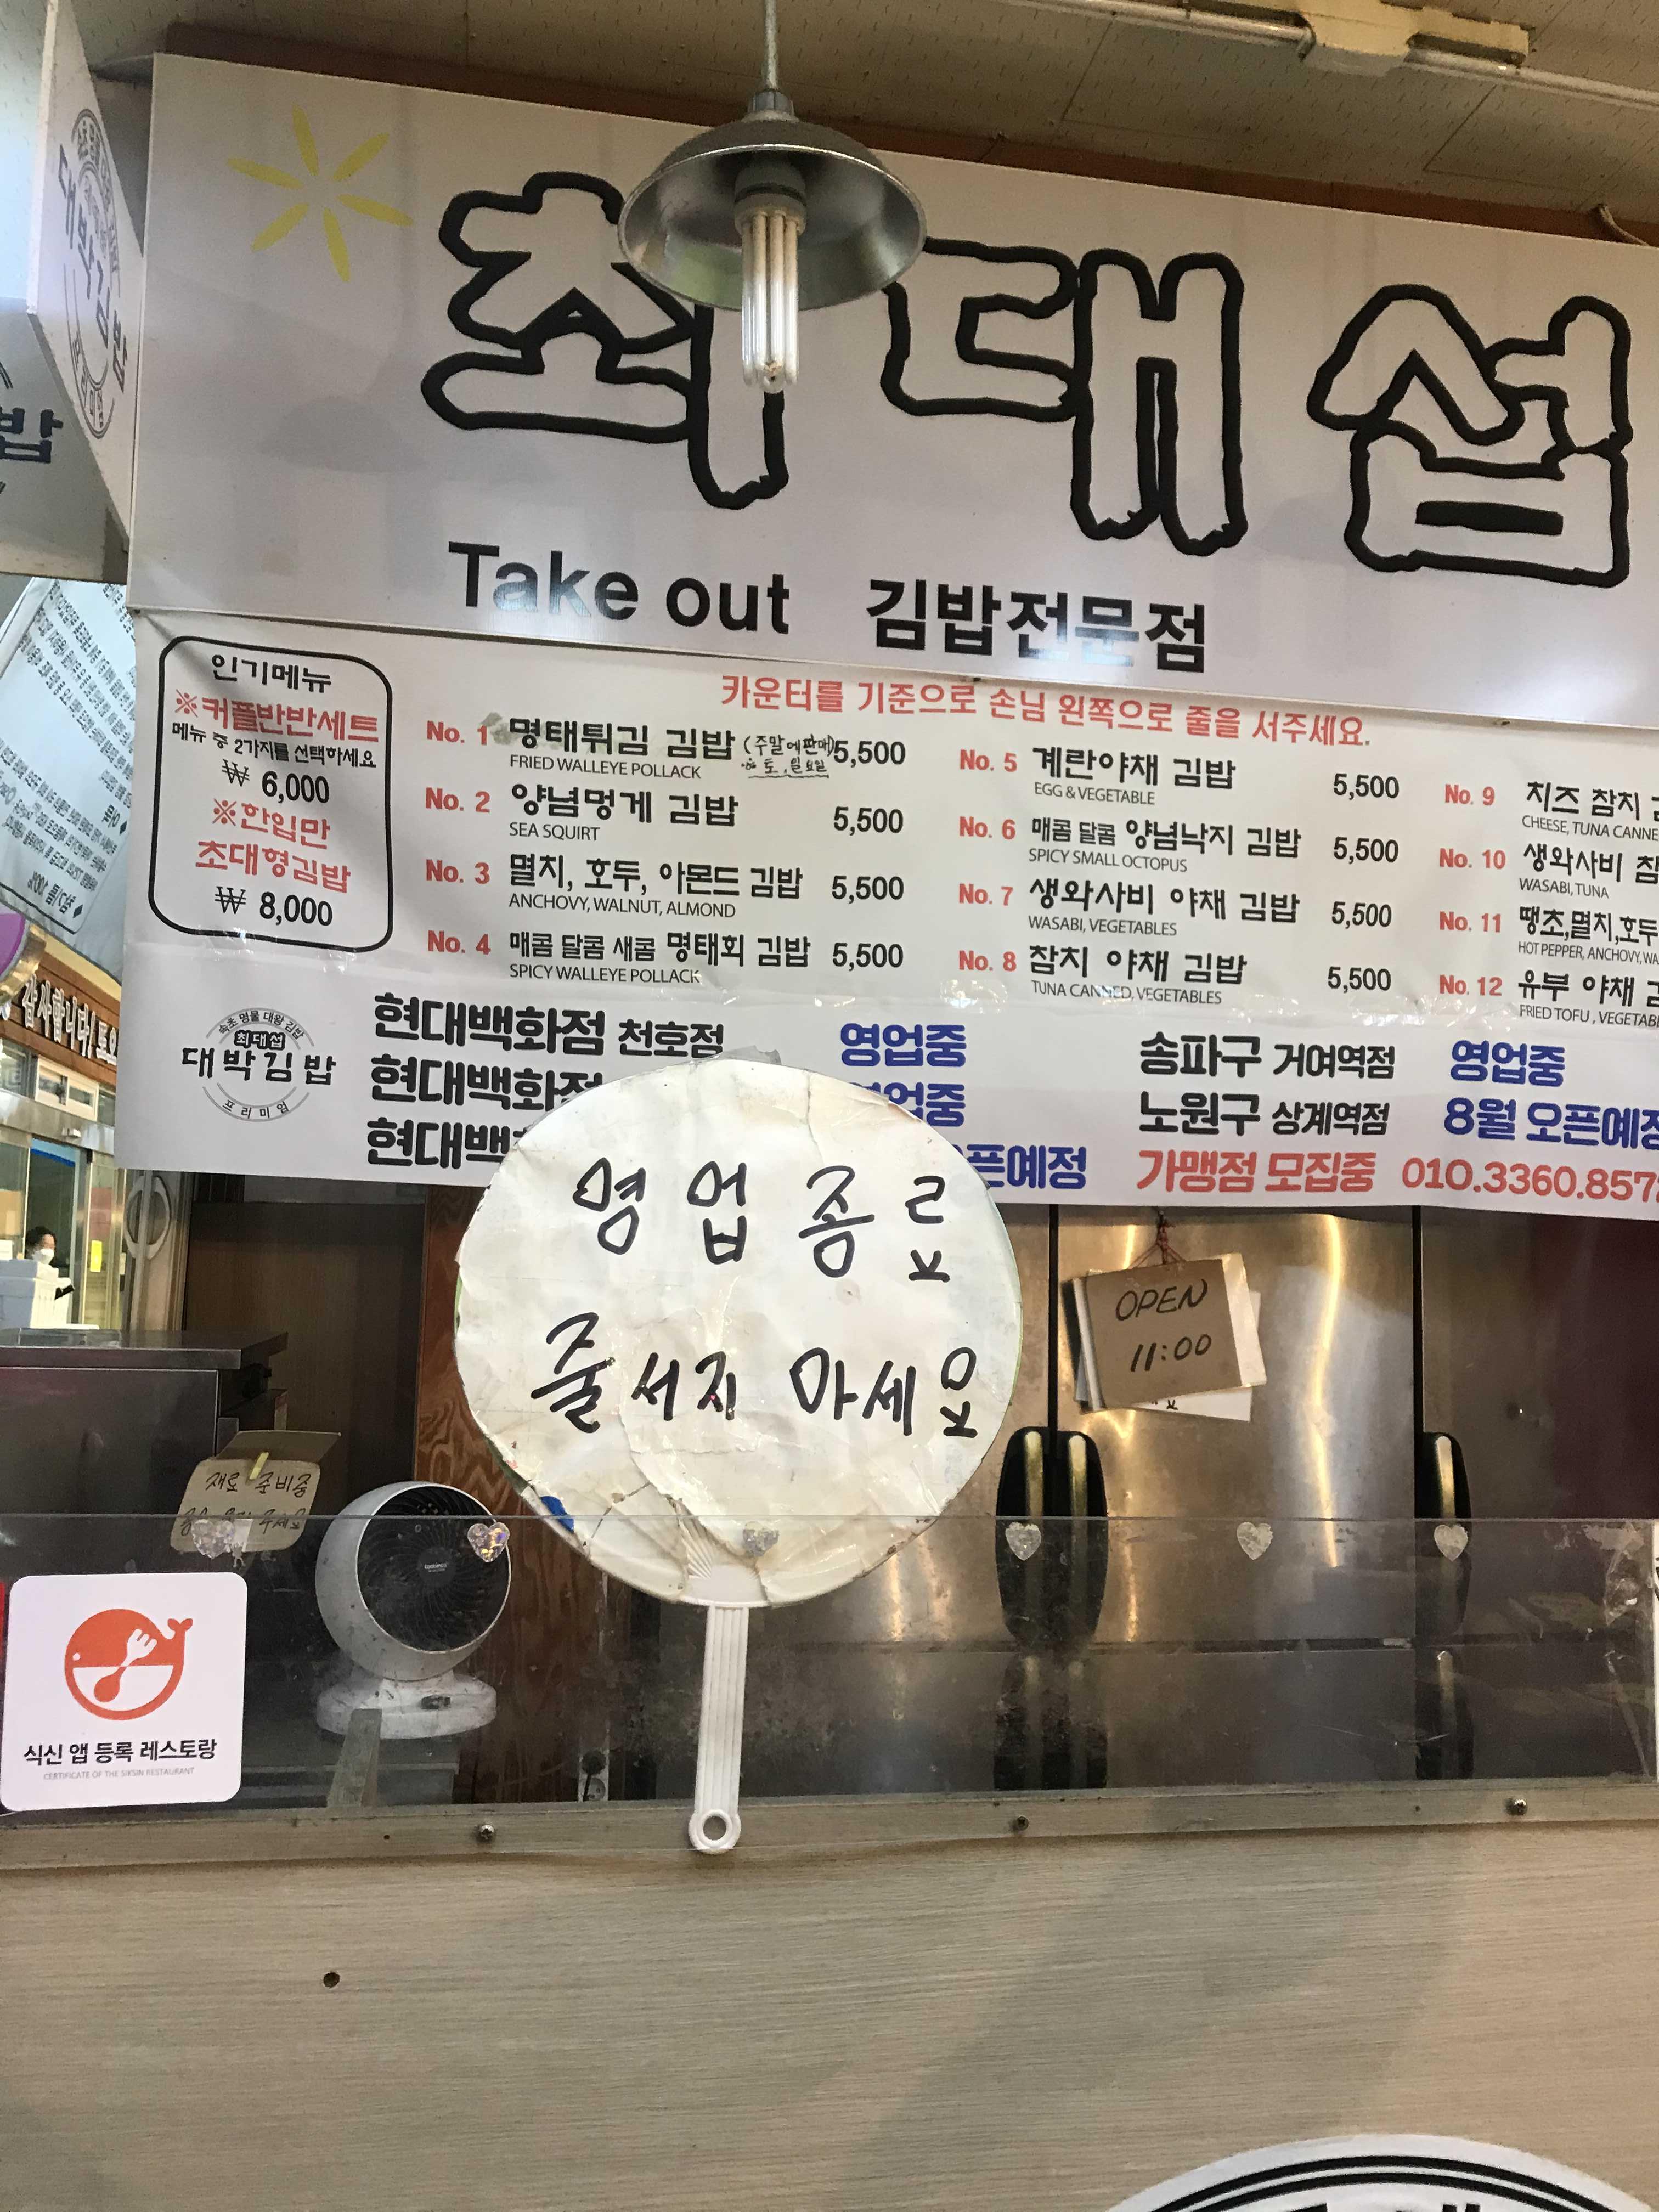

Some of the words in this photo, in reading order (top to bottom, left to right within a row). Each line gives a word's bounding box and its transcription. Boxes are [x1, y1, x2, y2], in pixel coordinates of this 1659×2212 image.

[448, 541, 637, 622] Take
[665, 573, 790, 635] out
[866, 577, 1206, 674] 김밥전문점
[212, 654, 331, 693] 인기메뉴
[721, 675, 844, 713] 카운터를
[858, 682, 977, 714] 기준으로
[990, 687, 1045, 723] 손님
[1058, 694, 1173, 732] 왼쪽으로
[1186, 705, 1241, 739] 줄을
[1252, 710, 1370, 747] 서주세요.
[172, 722, 206, 742] 메뉴
[212, 732, 228, 749] 중
[234, 738, 290, 761] 2가지를
[294, 744, 377, 768] 선택하세요
[427, 720, 465, 743] No.
[477, 725, 488, 746] 1
[509, 718, 648, 757] 명태튀김
[666, 728, 736, 761] 김밥
[834, 740, 906, 768] 5,500
[510, 754, 555, 771] FRIED
[556, 758, 628, 776] WALLEYE
[631, 762, 701, 779] POLLACK
[960, 749, 994, 771] No.
[1003, 753, 1018, 772] 5
[1032, 746, 1159, 786] 계란야채
[1173, 757, 1237, 790] 김밥
[262, 771, 330, 803] 6,000
[1034, 782, 1063, 798] EGG
[1065, 786, 1076, 799] &
[1077, 786, 1155, 805] VEGETABLE
[1334, 773, 1400, 800] 5,500
[1445, 783, 1474, 805] No.
[1482, 786, 1495, 806] 9
[1526, 781, 1580, 814] 치즈
[1591, 788, 1640, 821] 참치
[425, 786, 464, 812] No.
[475, 791, 490, 813] 2
[511, 783, 652, 823] 양념멍게
[669, 794, 739, 827] 김밥
[833, 806, 904, 835] 5,500
[509, 822, 539, 838] SEA
[542, 823, 600, 841] SQUIRT
[959, 816, 993, 838] No.
[1002, 819, 1016, 840] 6
[1032, 817, 1071, 843] 매콤
[1079, 821, 1116, 846] 달콤
[1126, 819, 1233, 856] 양념낙지
[1246, 827, 1302, 859] 김밥
[1522, 815, 1570, 835] CHEESE,
[1572, 821, 1610, 837] TUNA
[1613, 825, 1658, 841] CANNE
[195, 841, 352, 893] 초대형김밥
[1028, 848, 1069, 865] SPICY
[1073, 851, 1119, 867] SMALL
[1122, 854, 1188, 873] OCTOPUS
[1334, 836, 1399, 865] 5,500
[1439, 848, 1472, 868] No.
[1481, 849, 1506, 870] 10
[1523, 843, 1623, 883] 생와사비
[426, 859, 464, 884] No.
[475, 861, 490, 885] 3
[510, 853, 574, 891] 멸치,
[584, 857, 647, 896] 호두,
[659, 861, 740, 896] 아몬드
[751, 866, 804, 899] 김밥
[832, 875, 905, 903] 5,500
[1519, 877, 1574, 895] WASABI,
[1576, 882, 1609, 900] TUNA
[259, 891, 332, 926] 8,000
[509, 893, 591, 913] ANCHOVY,
[594, 897, 663, 917] WALNUT,
[666, 901, 736, 918] ALMOND
[959, 883, 992, 906] No.
[1001, 886, 1014, 906] 7
[1029, 878, 1154, 916] 생와사비
[1170, 887, 1226, 921] 야채
[1240, 891, 1301, 924] 김밥
[1331, 901, 1392, 929] 5,500
[1028, 915, 1086, 934] WASABI,
[1089, 918, 1177, 936] VEGETABLES
[1439, 911, 1472, 932] No.
[1481, 913, 1502, 933] 11
[428, 930, 466, 953] No.
[476, 933, 492, 955] 4
[510, 931, 553, 958] 매콤
[562, 934, 605, 960] 달콤
[613, 935, 656, 963] 새콤
[667, 932, 744, 967] 명태회
[757, 936, 811, 968] 김밥
[832, 943, 904, 970] 5,500
[959, 950, 993, 972] No.
[1003, 951, 1017, 972] 8
[1029, 945, 1088, 978] 참치
[1107, 950, 1169, 983] 야채
[1184, 953, 1247, 985] 김밥
[1518, 941, 1539, 955] HOT
[1540, 943, 1585, 961] PEPPER,
[1587, 946, 1643, 966] ANCHOVY,
[510, 963, 553, 979] SPICY
[556, 966, 627, 982] WALLEYE
[630, 969, 701, 984] POLLACK
[1328, 966, 1392, 994] 5,500
[1439, 974, 1470, 996] No.
[1477, 976, 1503, 997] 12
[1518, 969, 1570, 1001] 유부
[1583, 974, 1635, 1007] 야채
[1031, 980, 1066, 996] TUNA
[1136, 987, 1222, 1005] VEGETABLES
[374, 992, 605, 1056] 현대백화점
[618, 1018, 724, 1058] 천호점
[1519, 1004, 1552, 1019] FRIED
[234, 1030, 286, 1051] 최대섭
[840, 1023, 967, 1067] 영업중
[1139, 1030, 1262, 1077] 송파구
[1272, 1042, 1396, 1080] 거여역점
[182, 1047, 336, 1086] 대박김밥
[1450, 1039, 1565, 1087] 영업중
[222, 1100, 289, 1119] 프리미엄
[1139, 1091, 1261, 1137] 노원구
[1272, 1101, 1390, 1136] 상계역점
[1444, 1097, 1516, 1141] 8월
[1137, 1149, 1257, 1193] 가맹점
[1265, 1152, 1376, 1193] 모집중
[1401, 1157, 1659, 1203] 010.3360.857
[1115, 1279, 1207, 1321] OPEN
[1130, 1334, 1212, 1372] 11:00
[531, 1312, 737, 1434] 줄서지
[205, 1472, 240, 1492] 재료
[255, 1471, 312, 1498] 준비중
[24, 1743, 63, 1766] 식신
[70, 1743, 88, 1765] 앱
[94, 1741, 134, 1763] 등록
[140, 1739, 218, 1761] 레스토랑
[43, 1770, 90, 1781] CERTIFICATE
[92, 1770, 102, 1779] OF
[104, 1769, 119, 1778] THE
[121, 1768, 144, 1777] SIKSIN
[146, 1767, 194, 1776] RESTAURANT
